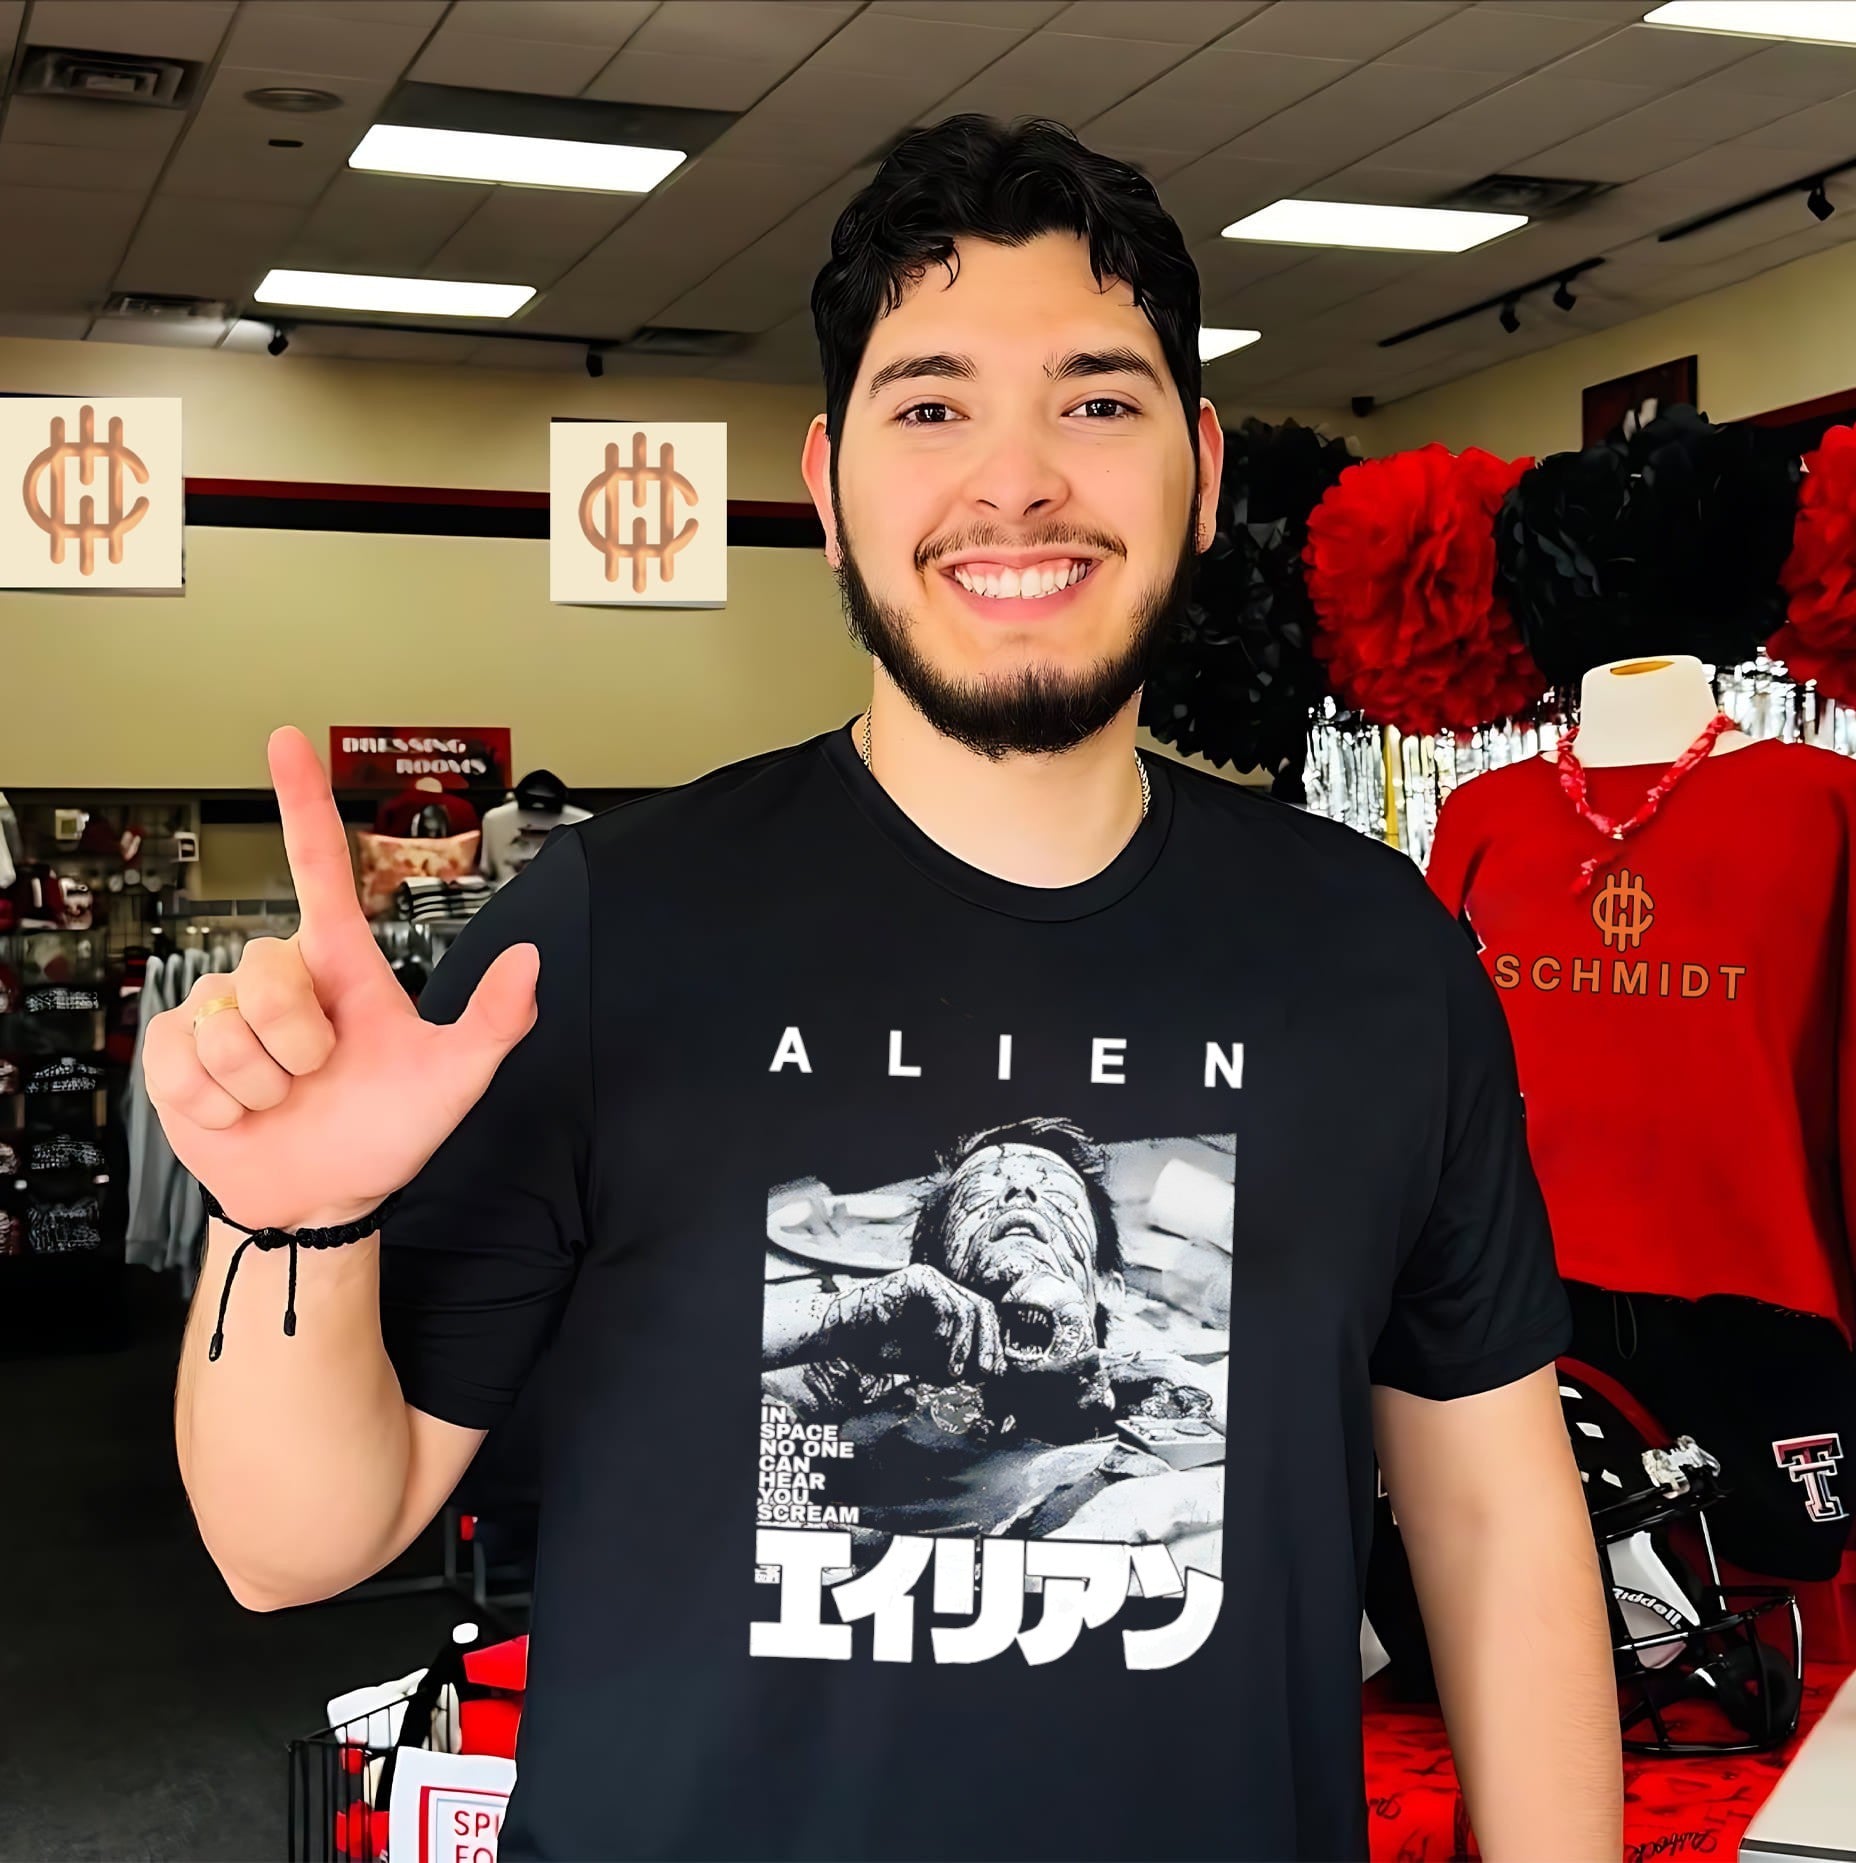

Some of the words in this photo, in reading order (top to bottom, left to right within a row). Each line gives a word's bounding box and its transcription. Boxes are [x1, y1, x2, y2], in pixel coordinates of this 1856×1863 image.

[342, 737, 467, 753] DRESSING
[396, 758, 487, 775] ROOMS
[1494, 953, 1747, 1000] SCHMIDT
[768, 1026, 1245, 1089] ALIEN
[761, 1406, 787, 1423] IN
[760, 1423, 839, 1441] SPACE
[759, 1439, 796, 1456] NO
[802, 1441, 855, 1458] ONE
[758, 1455, 810, 1473] CAN
[758, 1471, 826, 1490] HEAR
[757, 1487, 810, 1505] YOU
[756, 1503, 860, 1523] SCREAM
[749, 1528, 1224, 1671] エイリアン
